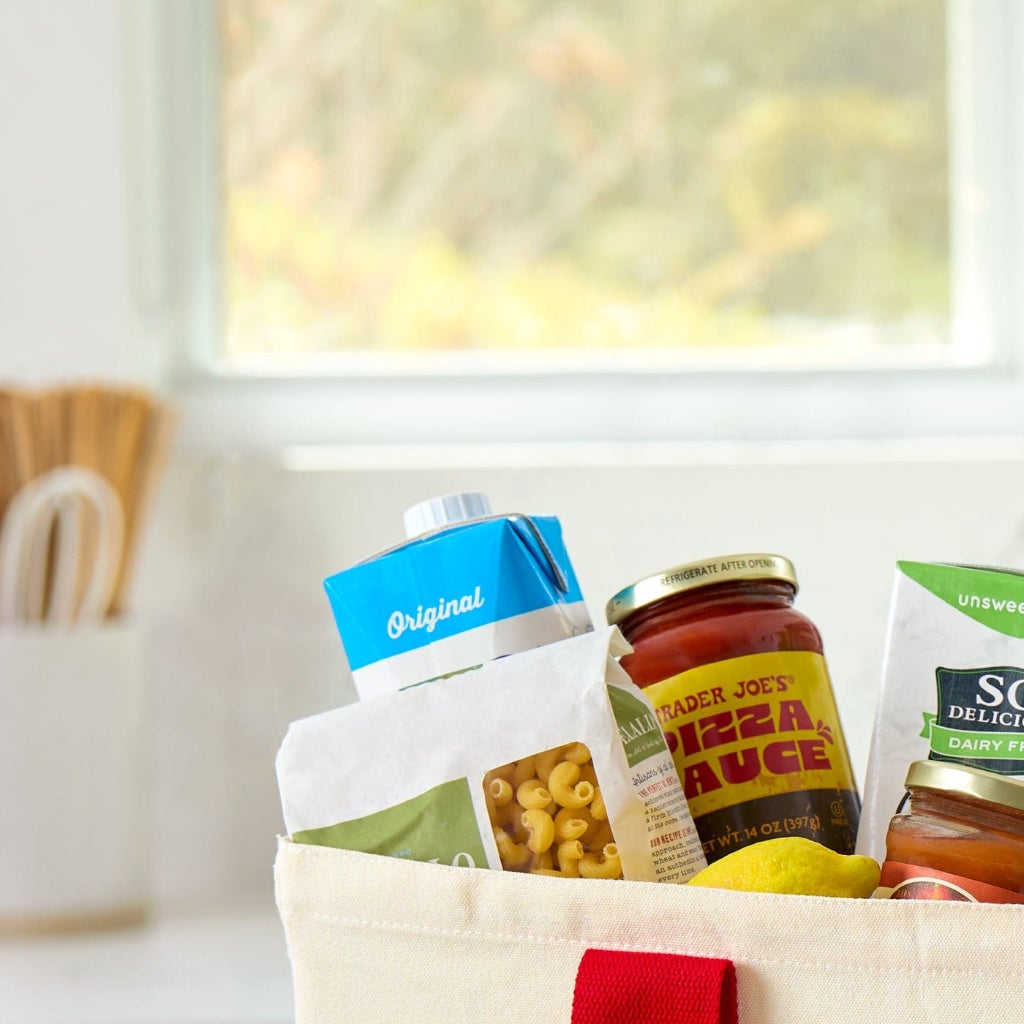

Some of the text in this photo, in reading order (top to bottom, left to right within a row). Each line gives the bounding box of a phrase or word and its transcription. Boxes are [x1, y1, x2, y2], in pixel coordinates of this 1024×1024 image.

[661, 565, 718, 586] REFRIGERATE
[721, 560, 746, 572] AFTER
[387, 586, 484, 639] Original
[949, 737, 1003, 751] DAIRY
[684, 739, 833, 799] AUCE
[661, 830, 682, 845] RECIPE
[702, 814, 821, 854] ET WT. 14 OZ (397g)
[653, 853, 676, 866] wheat
[656, 867, 665, 875] an
